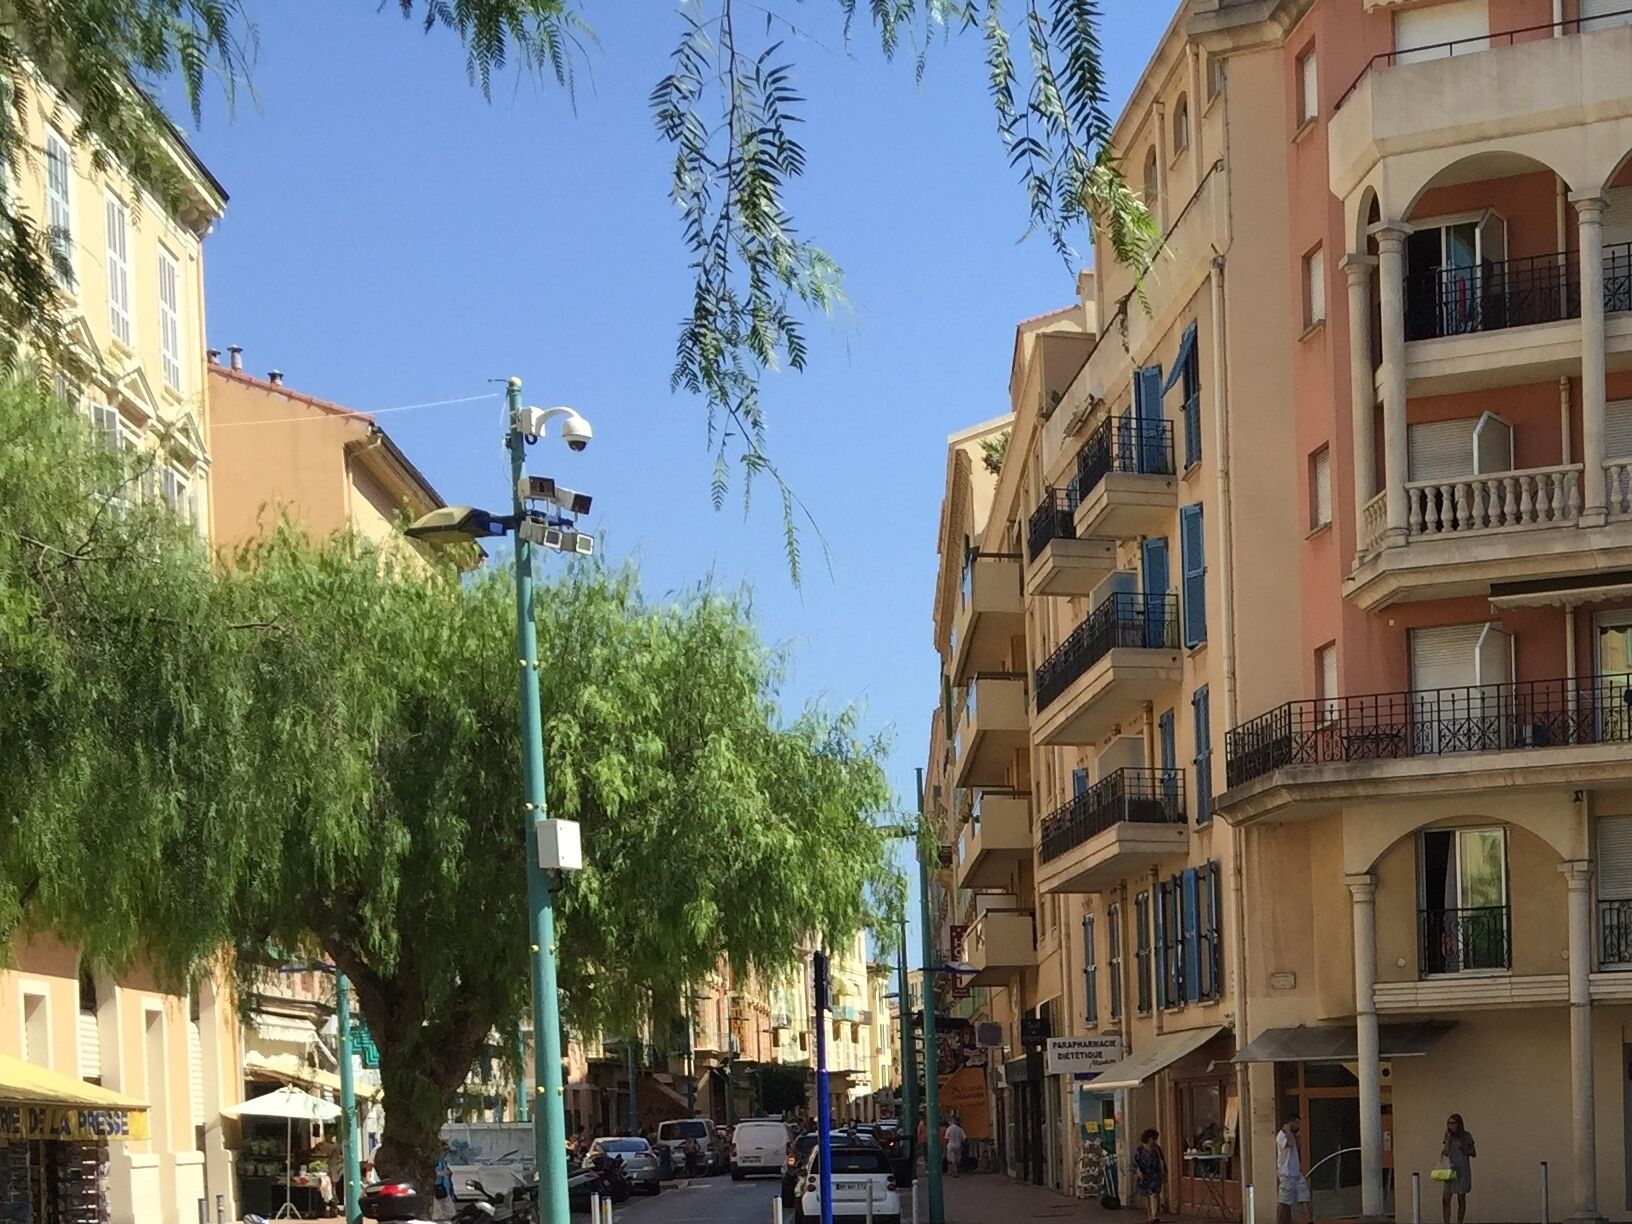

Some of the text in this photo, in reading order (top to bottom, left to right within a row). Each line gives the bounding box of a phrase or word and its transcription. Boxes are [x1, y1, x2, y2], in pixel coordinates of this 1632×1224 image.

[1052, 1039, 1117, 1049] PARAPHARMACIE
[29, 1107, 46, 1134] DE
[50, 1109, 72, 1136] LA
[78, 1109, 130, 1136] PRESSE
